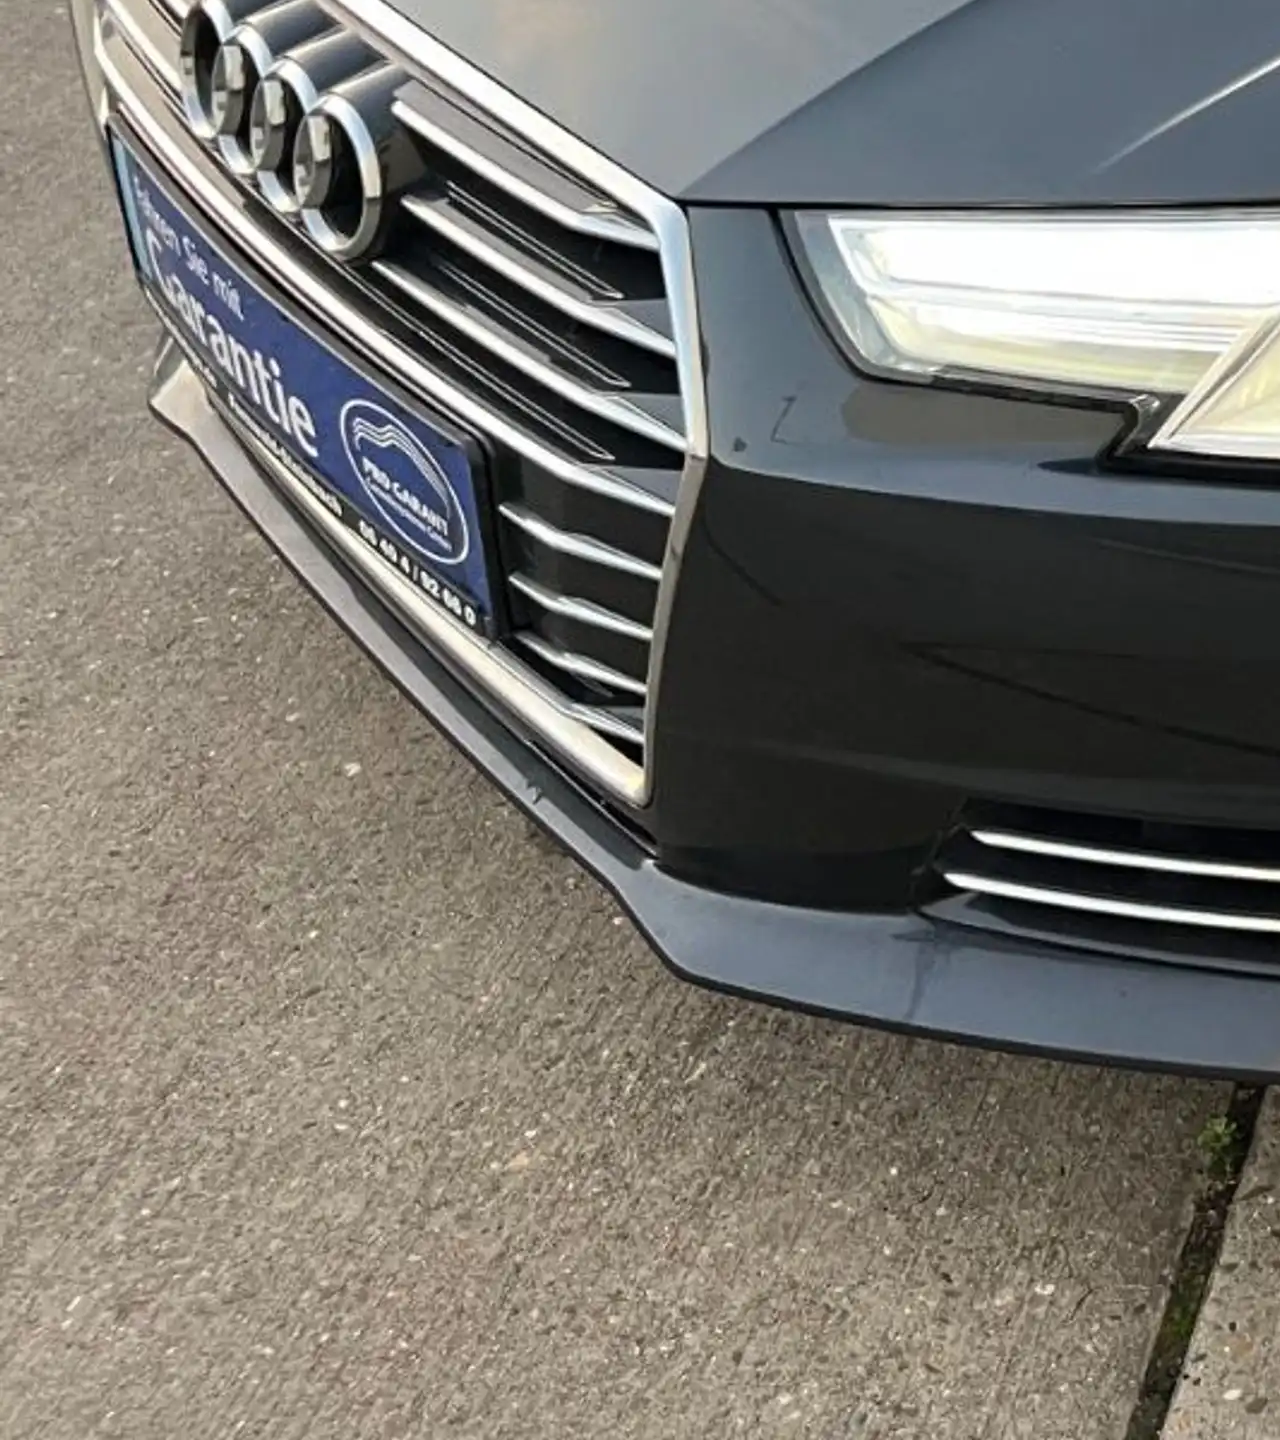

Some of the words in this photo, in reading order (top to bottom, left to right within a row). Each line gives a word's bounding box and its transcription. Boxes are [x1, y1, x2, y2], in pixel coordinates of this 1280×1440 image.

[146, 227, 320, 458] Garantie
[182, 235, 210, 286] Sie
[212, 271, 245, 321] mit
